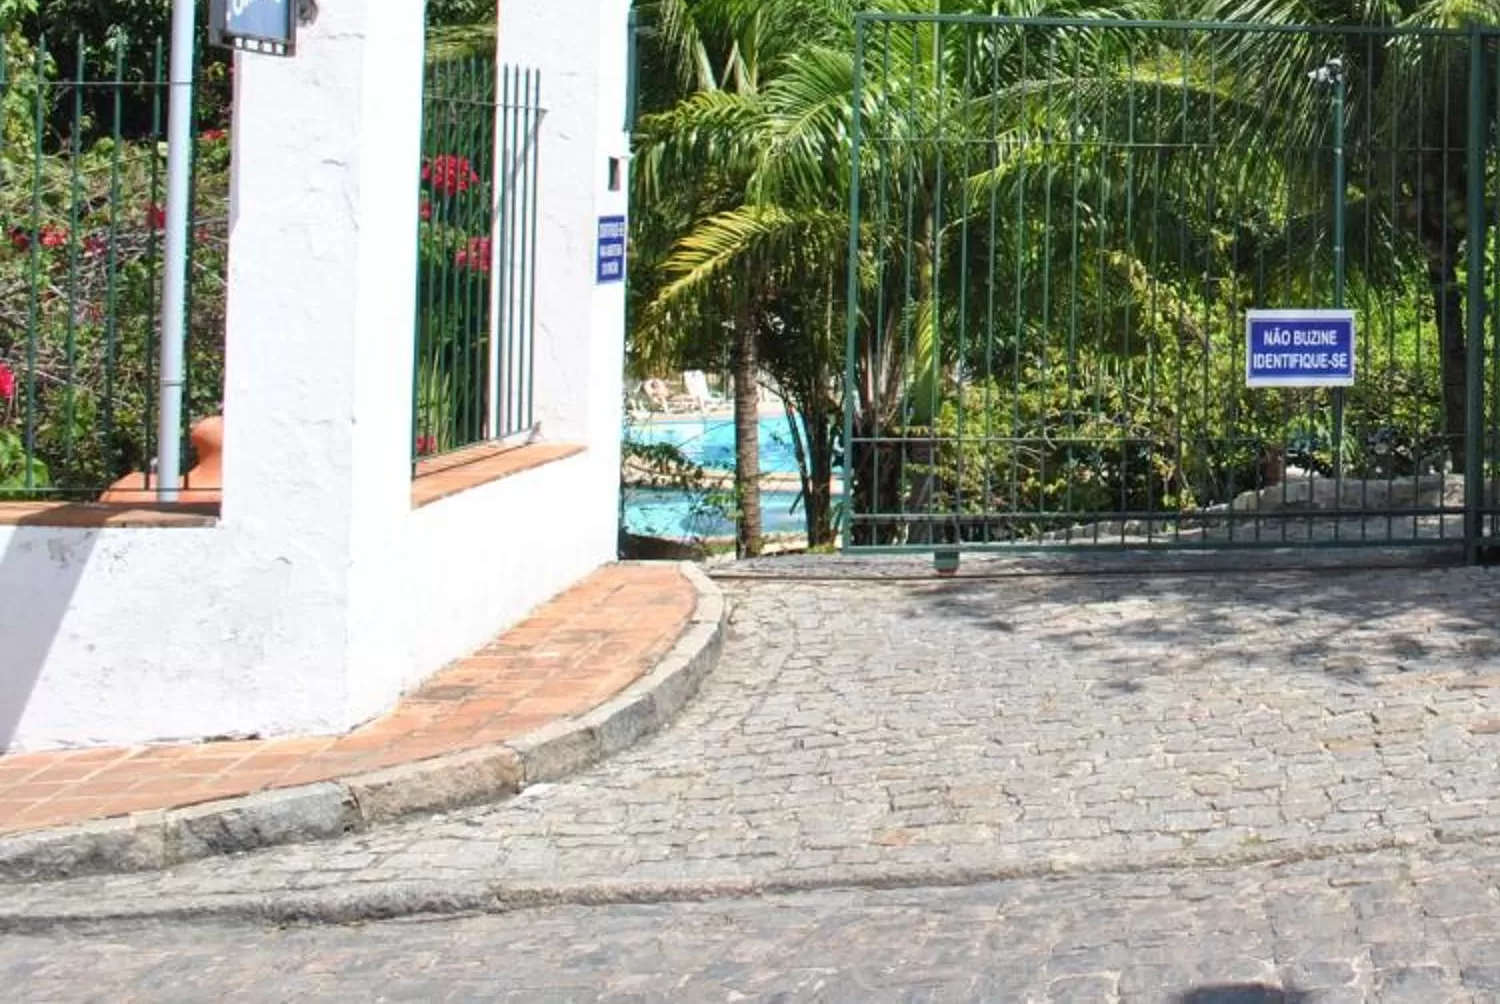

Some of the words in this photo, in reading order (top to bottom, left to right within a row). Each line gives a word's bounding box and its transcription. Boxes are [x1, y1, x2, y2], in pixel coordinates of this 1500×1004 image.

[1263, 327, 1291, 346] NÃO
[1293, 329, 1338, 346] BUZINE
[1253, 353, 1348, 369] IDENTIFIQUE-SE
